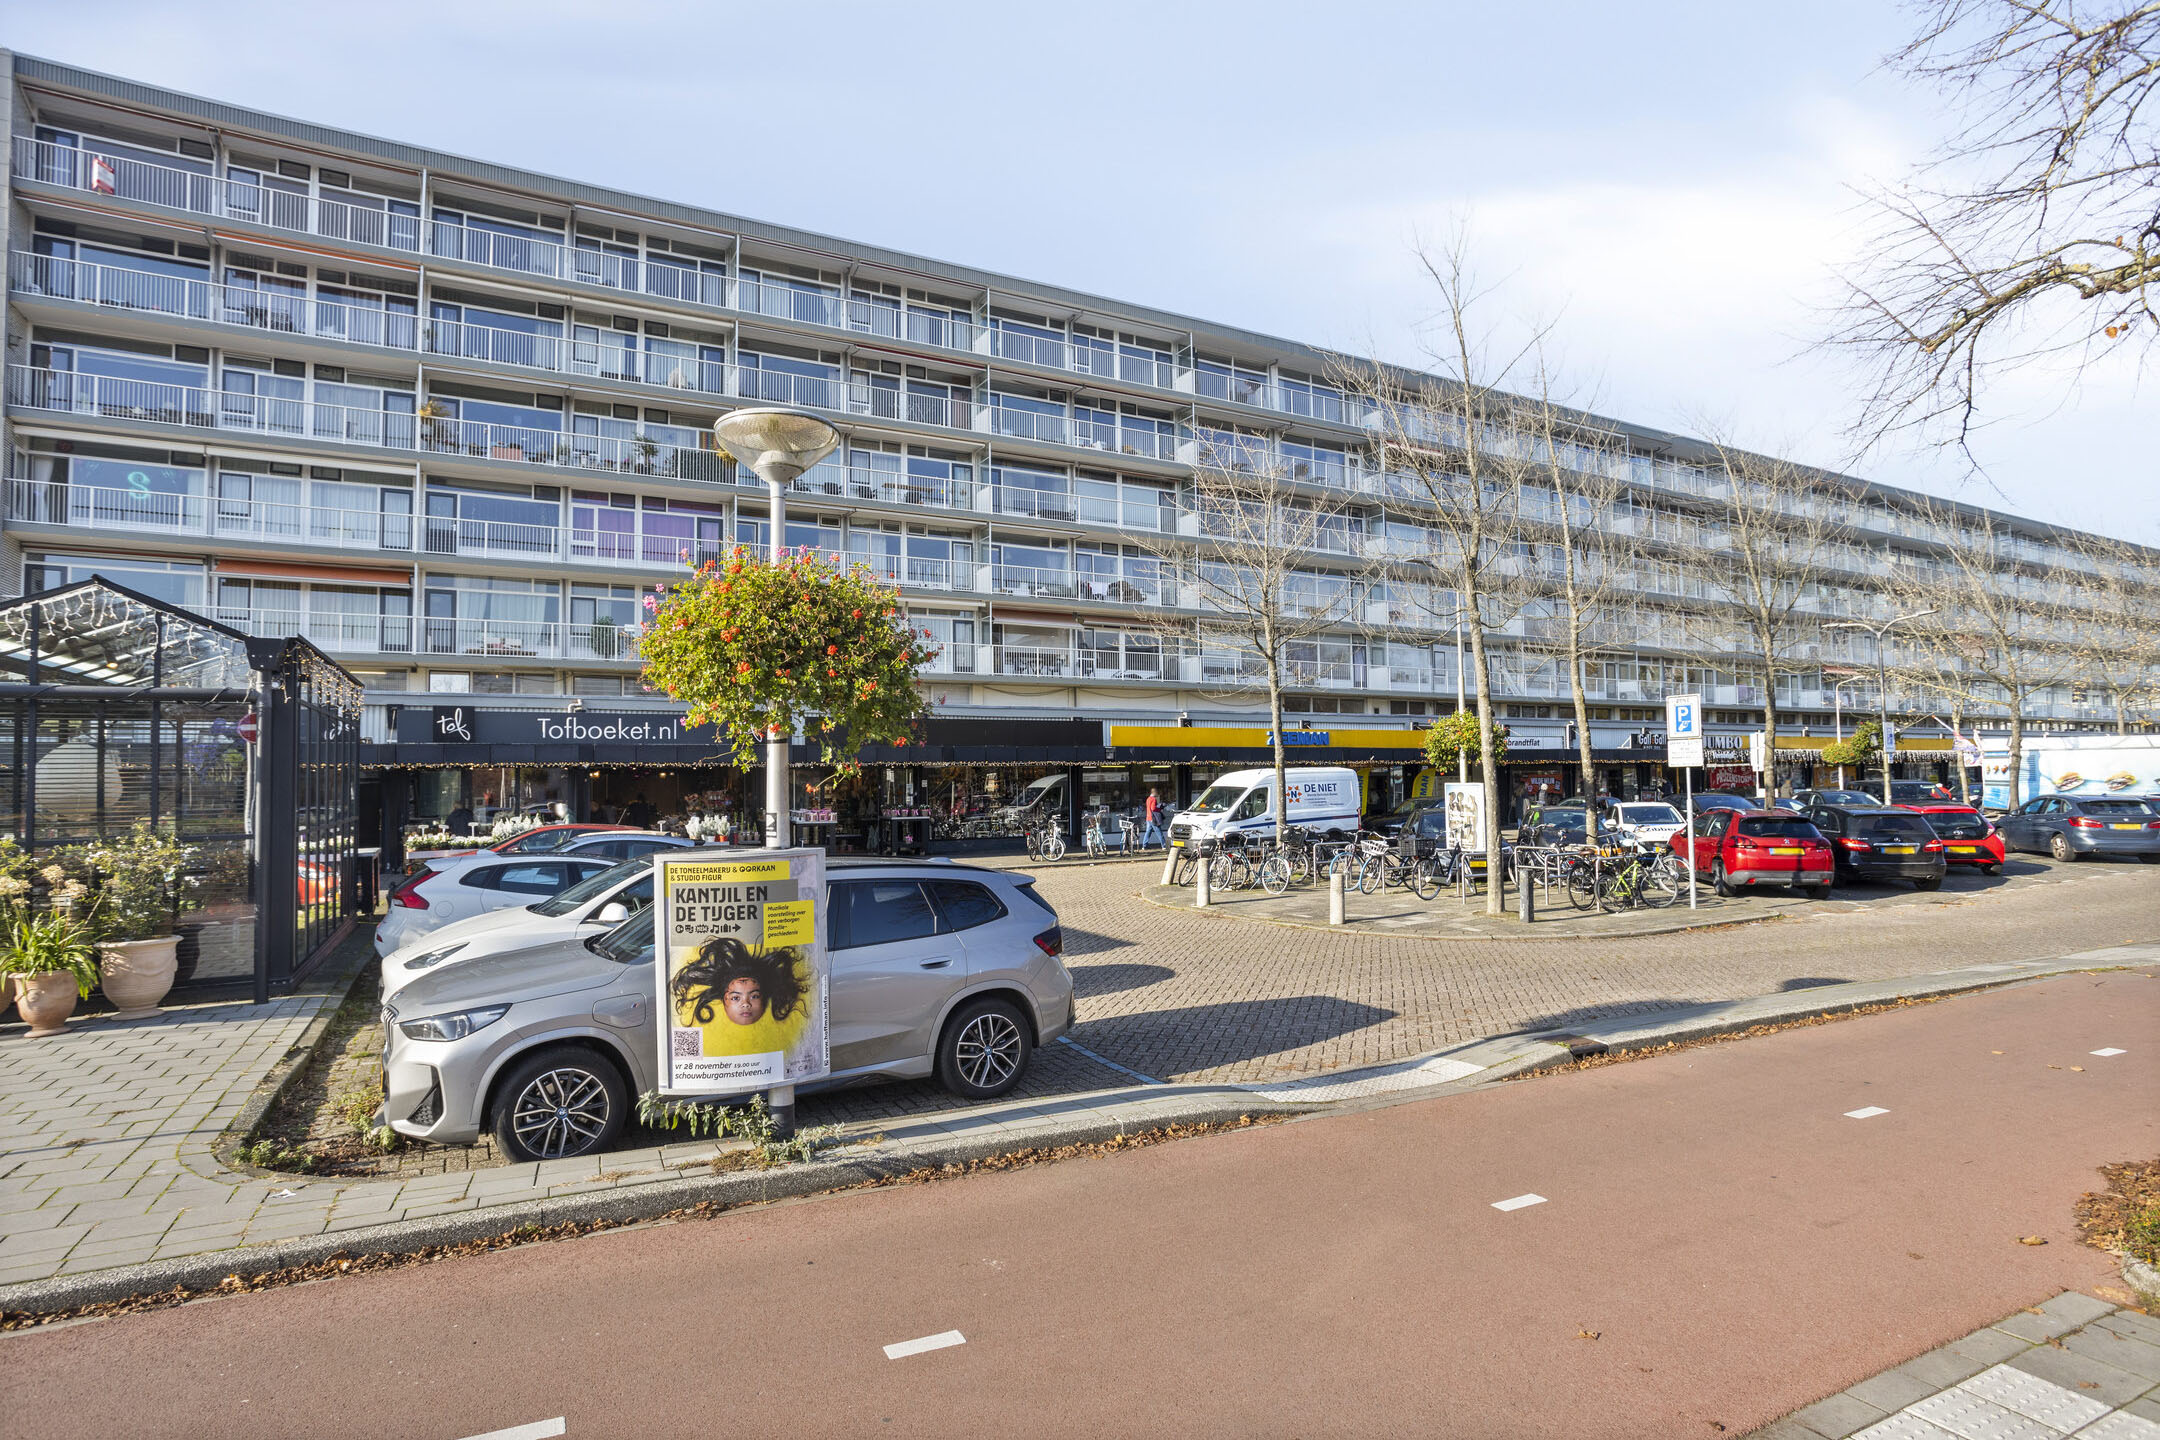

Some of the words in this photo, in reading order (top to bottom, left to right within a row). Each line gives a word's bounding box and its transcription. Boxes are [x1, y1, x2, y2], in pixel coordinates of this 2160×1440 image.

[436, 707, 471, 741] tof
[537, 717, 678, 740] Tofboeket.nl
[1304, 783, 1317, 792] DE
[1317, 783, 1337, 792] NIET
[679, 866, 731, 874] TONEELMAKERIJ
[675, 887, 742, 904] KANTJIL
[746, 886, 768, 902] EN
[675, 906, 696, 922] DE
[700, 905, 758, 922] TIJGER
[683, 1062, 693, 1070] 28
[694, 1062, 732, 1070] november
[674, 1067, 772, 1081] schouwburgamstelveen.nl
